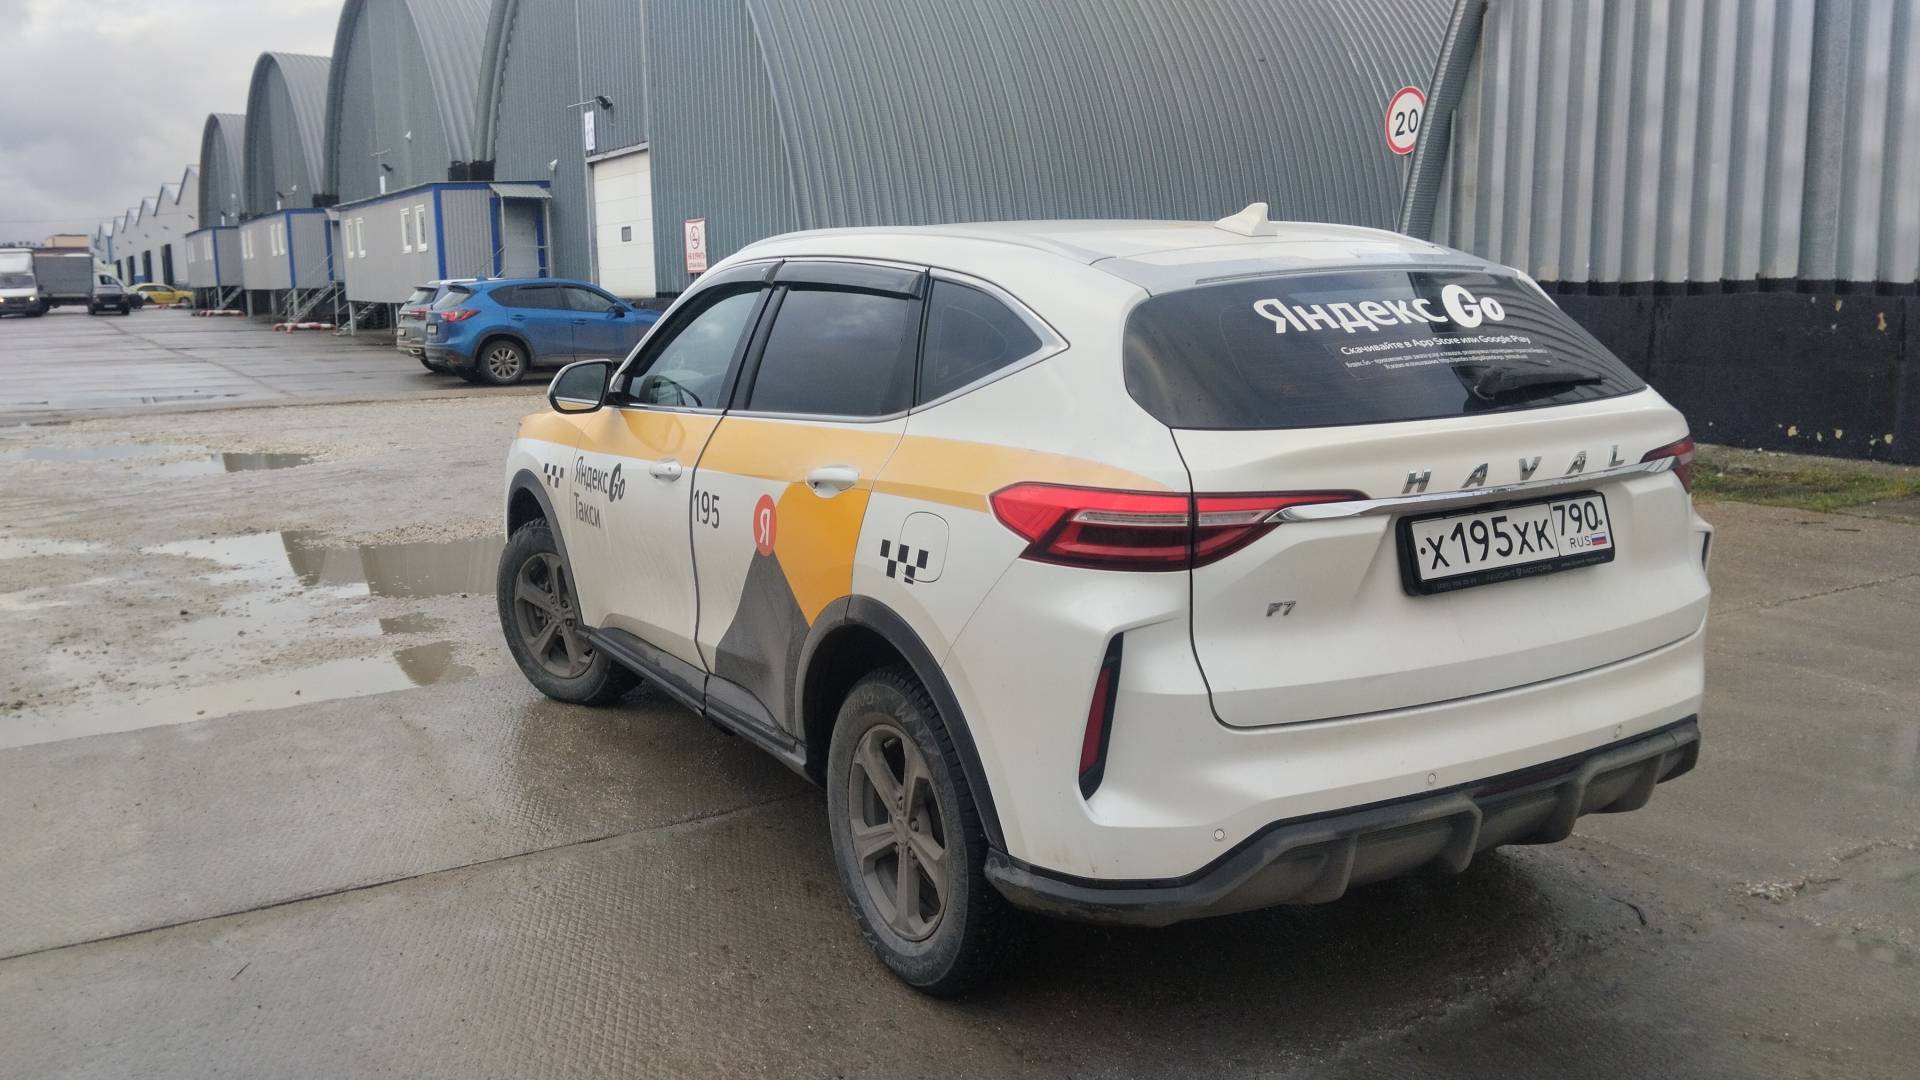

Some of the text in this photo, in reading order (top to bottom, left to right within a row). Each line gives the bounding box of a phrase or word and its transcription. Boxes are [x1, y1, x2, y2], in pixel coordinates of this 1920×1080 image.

[1395, 108, 1419, 137] 20
[1253, 284, 1506, 334] Яндекс Go
[1340, 341, 1404, 355] Скачивайте
[1413, 339, 1434, 348] App
[1433, 337, 1461, 345] Store
[1461, 336, 1479, 344] или
[1479, 335, 1510, 344] Google
[1509, 335, 1531, 344] Play
[574, 456, 625, 502] Яндекс Go
[1402, 444, 1625, 494] HAVAL
[574, 492, 601, 529] Такси
[693, 489, 720, 529] 195
[759, 508, 771, 546] Я
[1552, 501, 1599, 536] 790
[1569, 535, 1591, 549] RUS
[1266, 600, 1297, 617] F7
